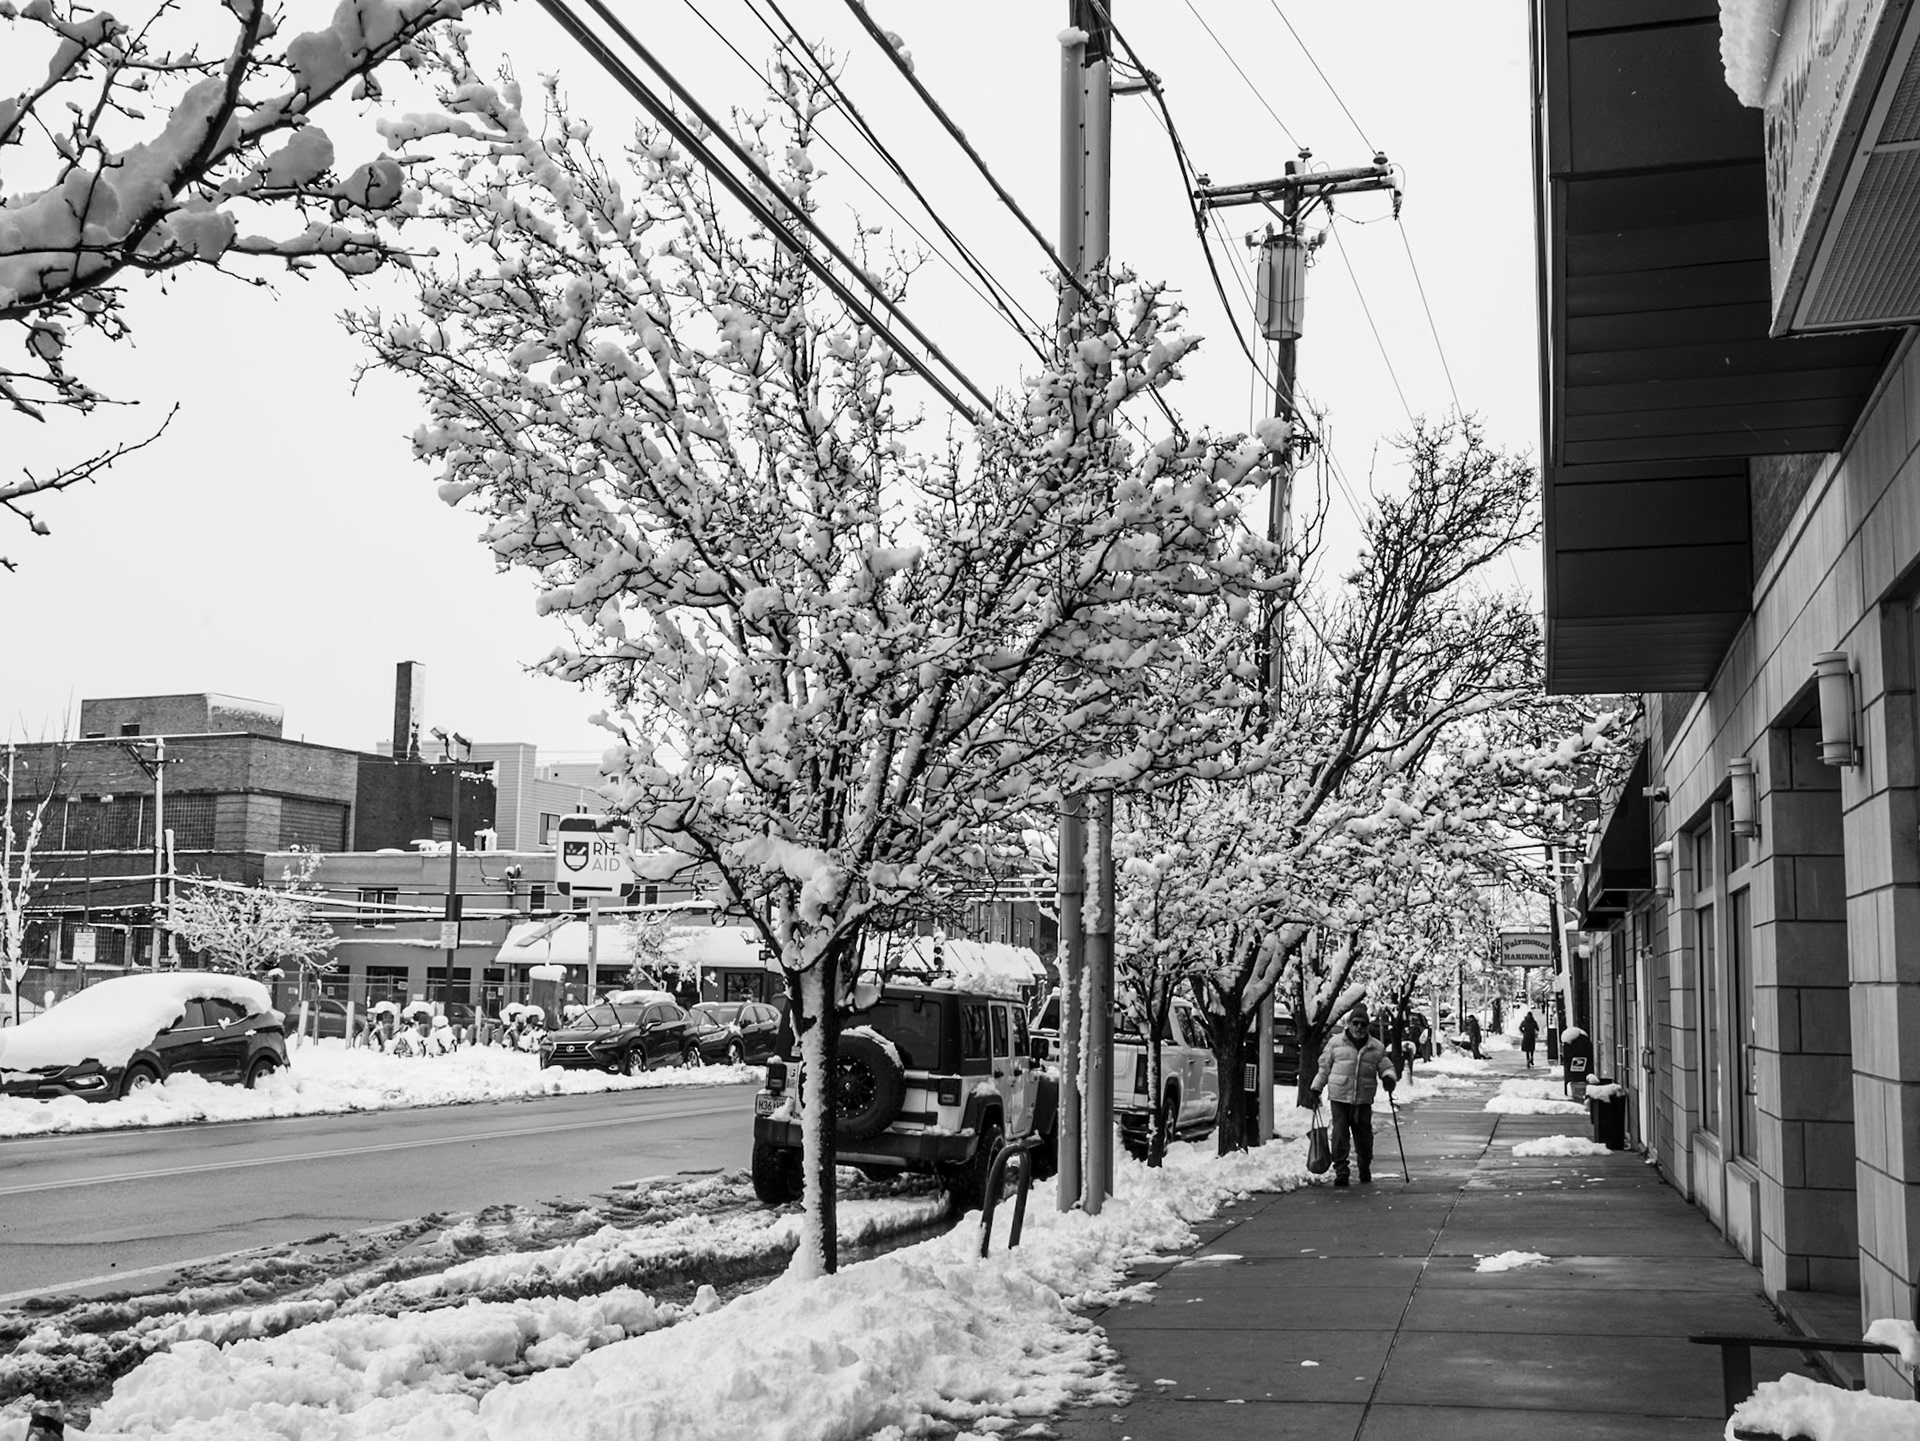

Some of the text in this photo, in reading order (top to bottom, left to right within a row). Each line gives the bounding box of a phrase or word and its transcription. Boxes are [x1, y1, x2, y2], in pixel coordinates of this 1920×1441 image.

[593, 842, 619, 856] RIT
[592, 858, 621, 872] AID
[1503, 938, 1550, 951] Fairmount
